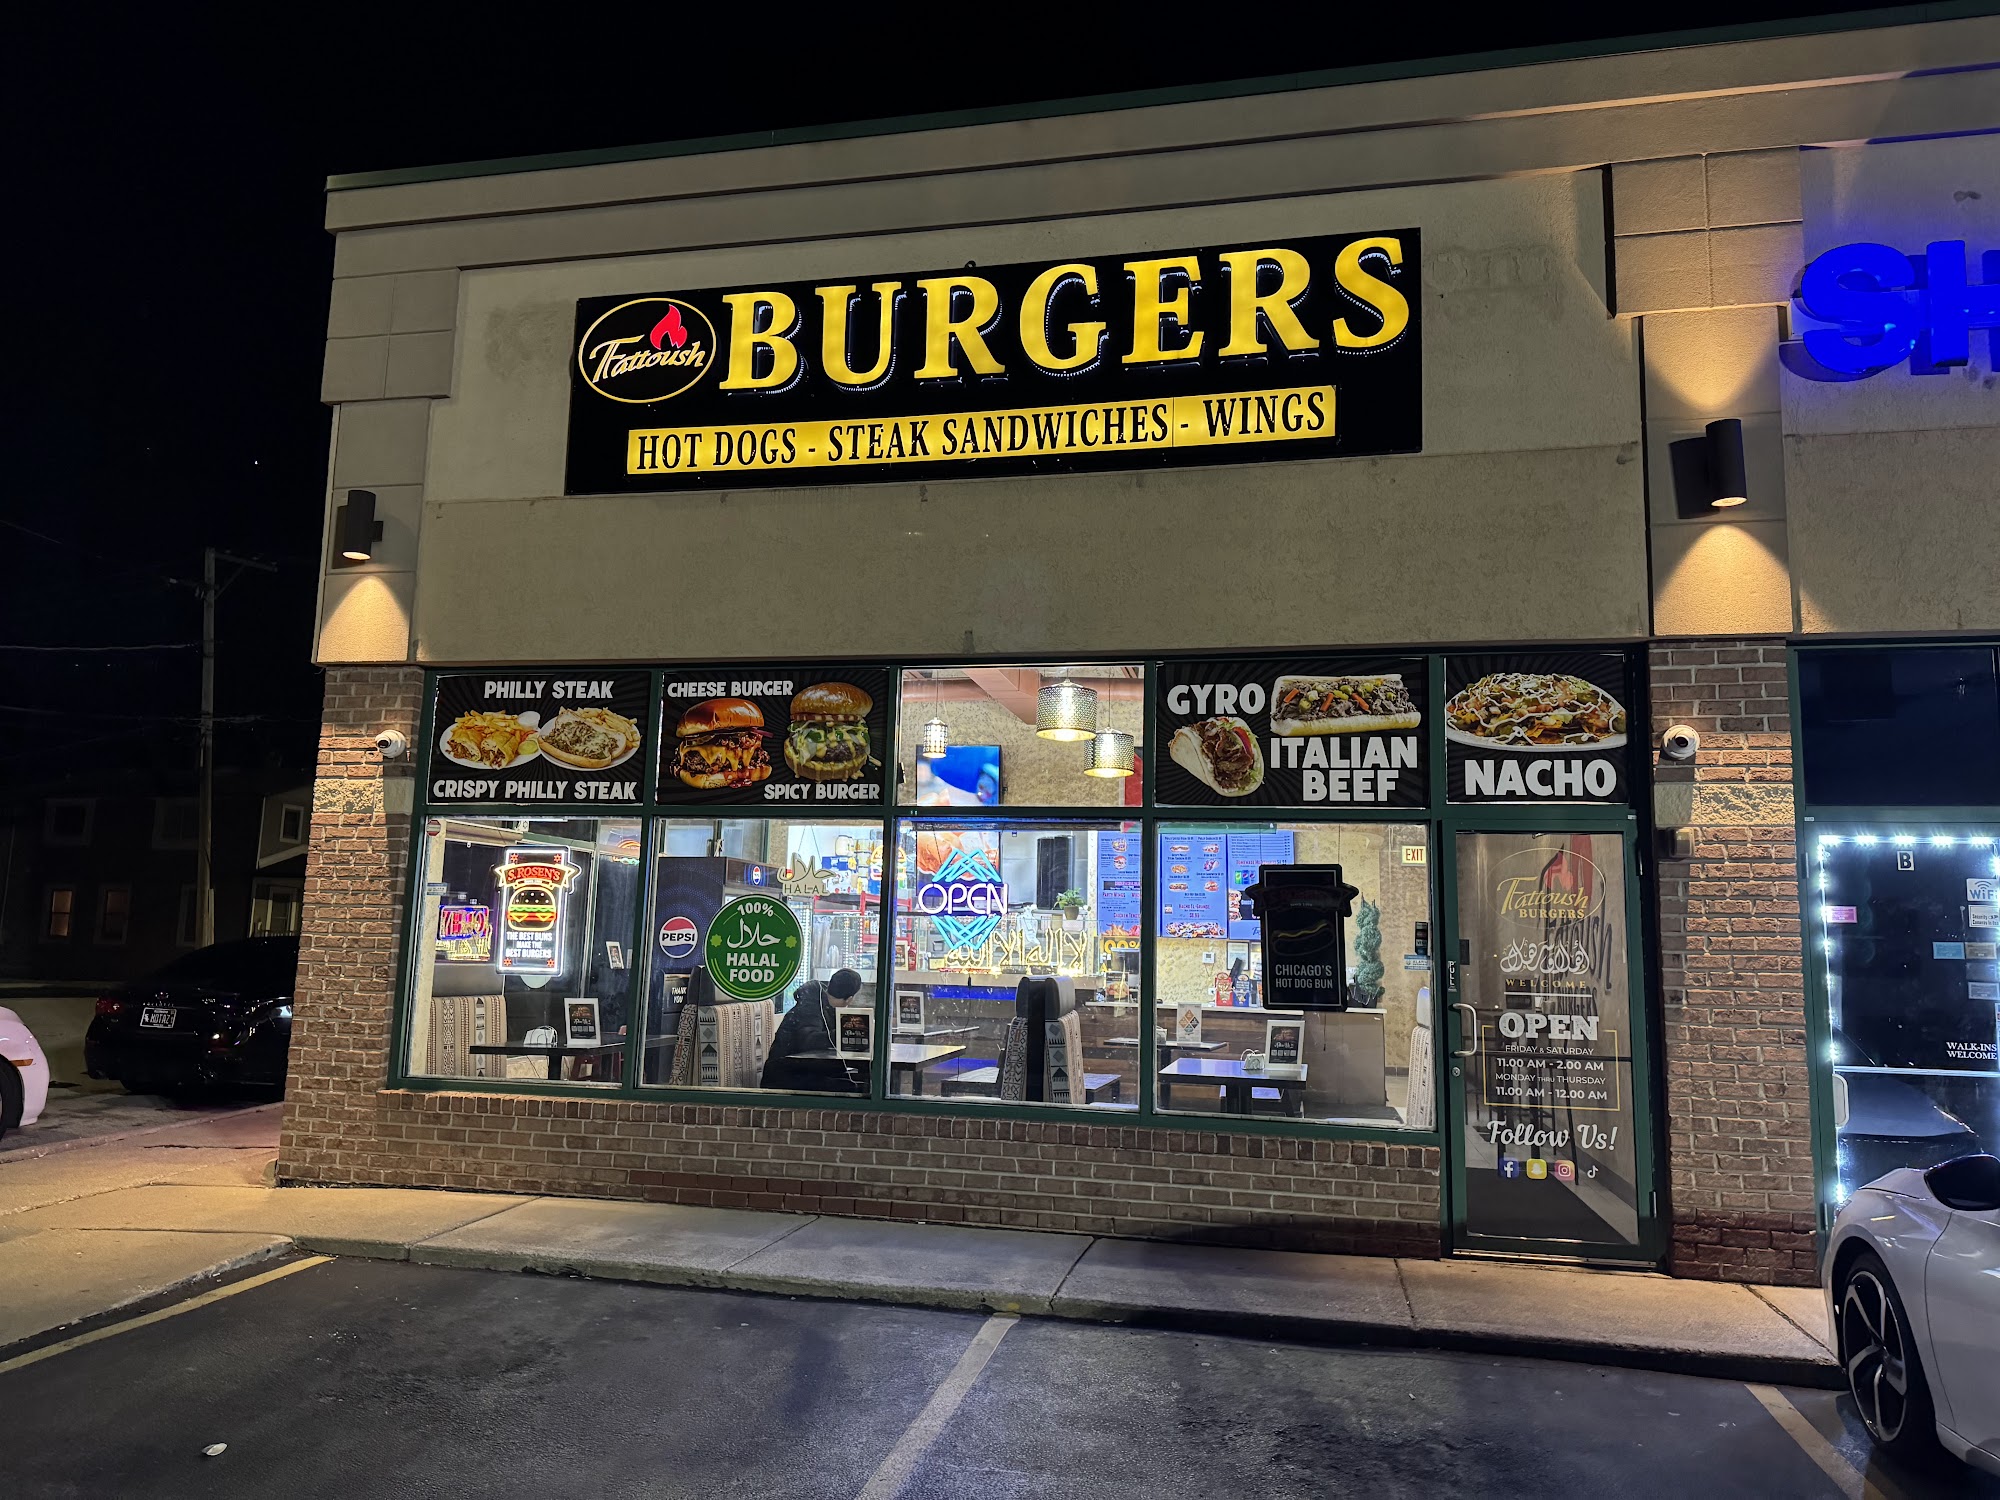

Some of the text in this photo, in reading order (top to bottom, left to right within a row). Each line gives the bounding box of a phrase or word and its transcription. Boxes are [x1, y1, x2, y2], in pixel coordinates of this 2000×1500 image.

[719, 237, 1410, 390] BURGERS
[590, 334, 706, 383] Fattoush
[637, 433, 702, 470] HOT
[713, 428, 797, 467] DOGS
[828, 420, 929, 462] STEAK
[941, 403, 1167, 456] SANDWICHES
[1203, 391, 1325, 437] WINGS
[484, 680, 613, 699] PHILLY STEAK
[667, 680, 793, 698] CHEESE BURGER
[1167, 683, 1266, 715] GYRO
[1270, 737, 1418, 769] ITALIAN
[1464, 759, 1617, 797] NACHO
[433, 780, 637, 800] CRISPY PHILLY STEAK
[764, 783, 880, 800] SPICY BURGER
[1302, 770, 1399, 802] BEEF
[1405, 848, 1424, 861] EXIT
[1900, 853, 1912, 869] B
[784, 884, 829, 894] HALAL
[1497, 876, 1589, 915] Fattoush
[918, 883, 1008, 914] OPEN
[736, 903, 774, 917] 100%
[1519, 908, 1585, 919] BURGERS
[506, 931, 518, 940] THE
[519, 931, 533, 940] BEST
[662, 932, 695, 942] PEPSI
[726, 918, 781, 949] حلال
[726, 953, 780, 967] HALAL
[729, 968, 775, 983] FOOD
[1275, 963, 1332, 977] CHICAGO'S
[1275, 977, 1333, 989] HOT DOG BUN
[1505, 978, 1586, 988] WELCOME
[673, 995, 684, 1004] YOU
[1499, 1012, 1599, 1041] OPEN
[1505, 1044, 1538, 1053] FRIDAY
[1546, 1046, 1594, 1056] SATURDAY
[1946, 1041, 1997, 1052] WALK-INS
[1946, 1050, 1998, 1060] WELCOME
[1497, 1058, 1524, 1068] 11.00
[1526, 1059, 1546, 1069] AM
[1556, 1060, 1582, 1070] 2.00
[1584, 1061, 1604, 1071] AM
[1495, 1073, 1536, 1082] MONDAY
[1556, 1075, 1606, 1085] THURSDAY
[1495, 1086, 1523, 1096] 11.00
[1525, 1087, 1545, 1097] AM
[1555, 1089, 1585, 1099] 12.00
[1587, 1090, 1608, 1100] AM
[1487, 1120, 1618, 1151] Follow Us!
